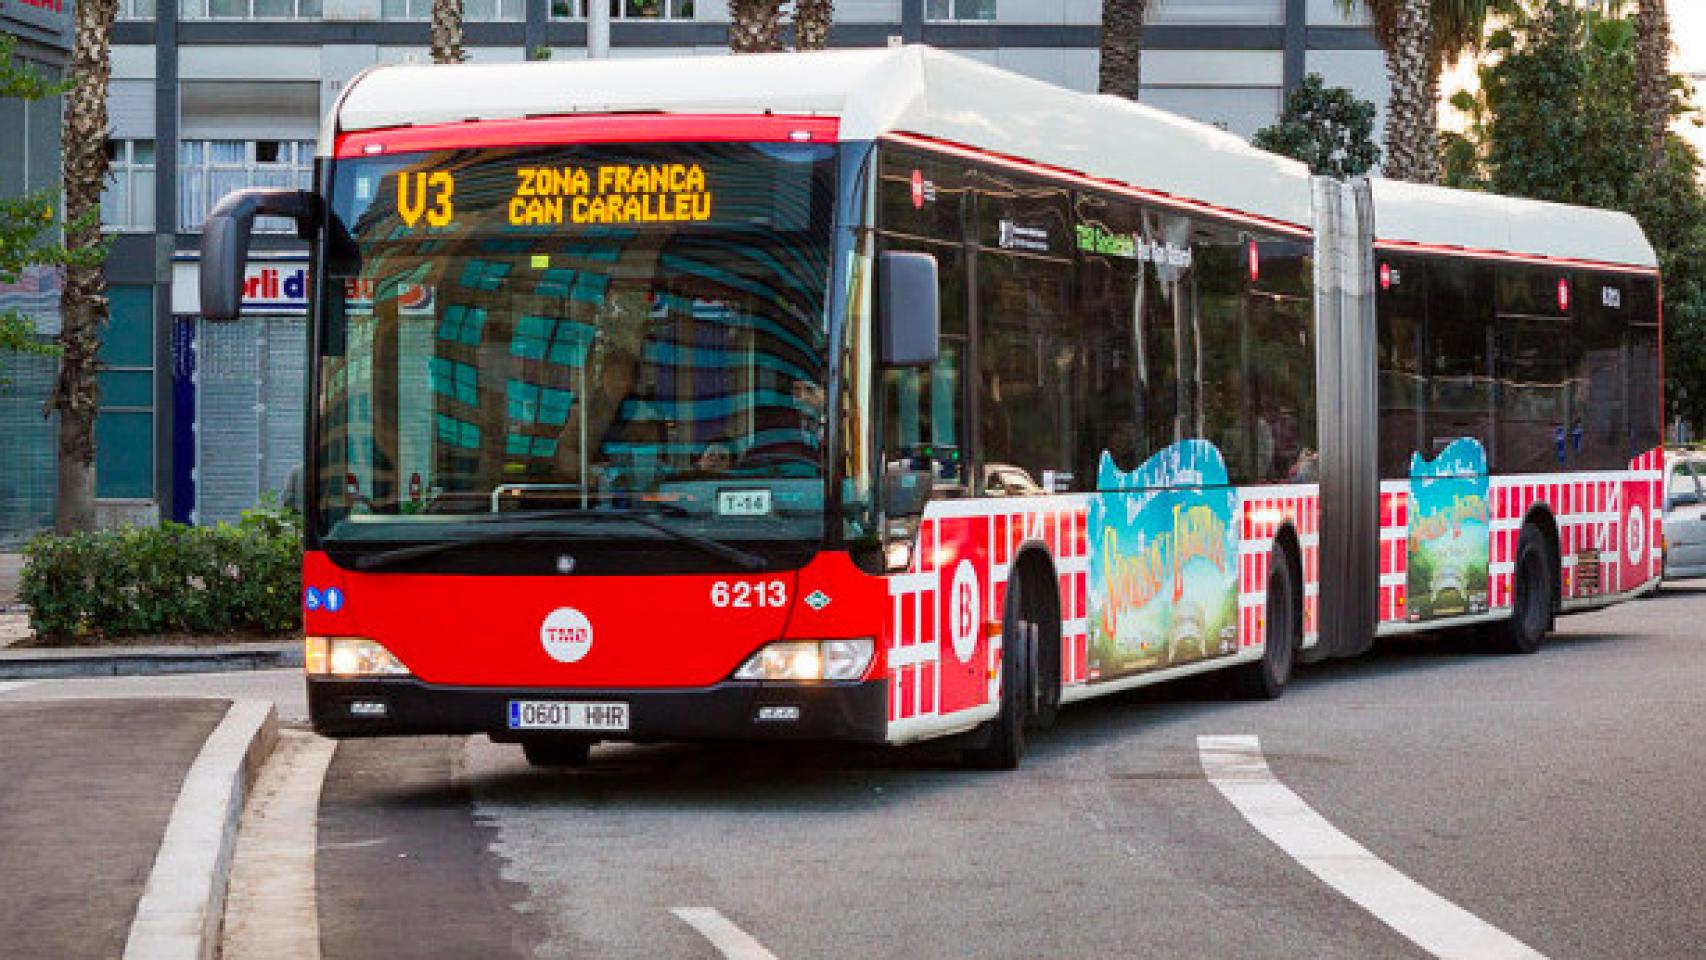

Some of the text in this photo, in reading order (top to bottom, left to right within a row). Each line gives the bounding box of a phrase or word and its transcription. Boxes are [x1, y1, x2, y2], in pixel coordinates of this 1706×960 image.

[517, 163, 705, 196] ZONA FRANCA
[398, 170, 454, 228] V3
[508, 191, 711, 226] CAN CARALLEU
[711, 580, 787, 608] 6213
[522, 703, 625, 727] 0601 HHR
